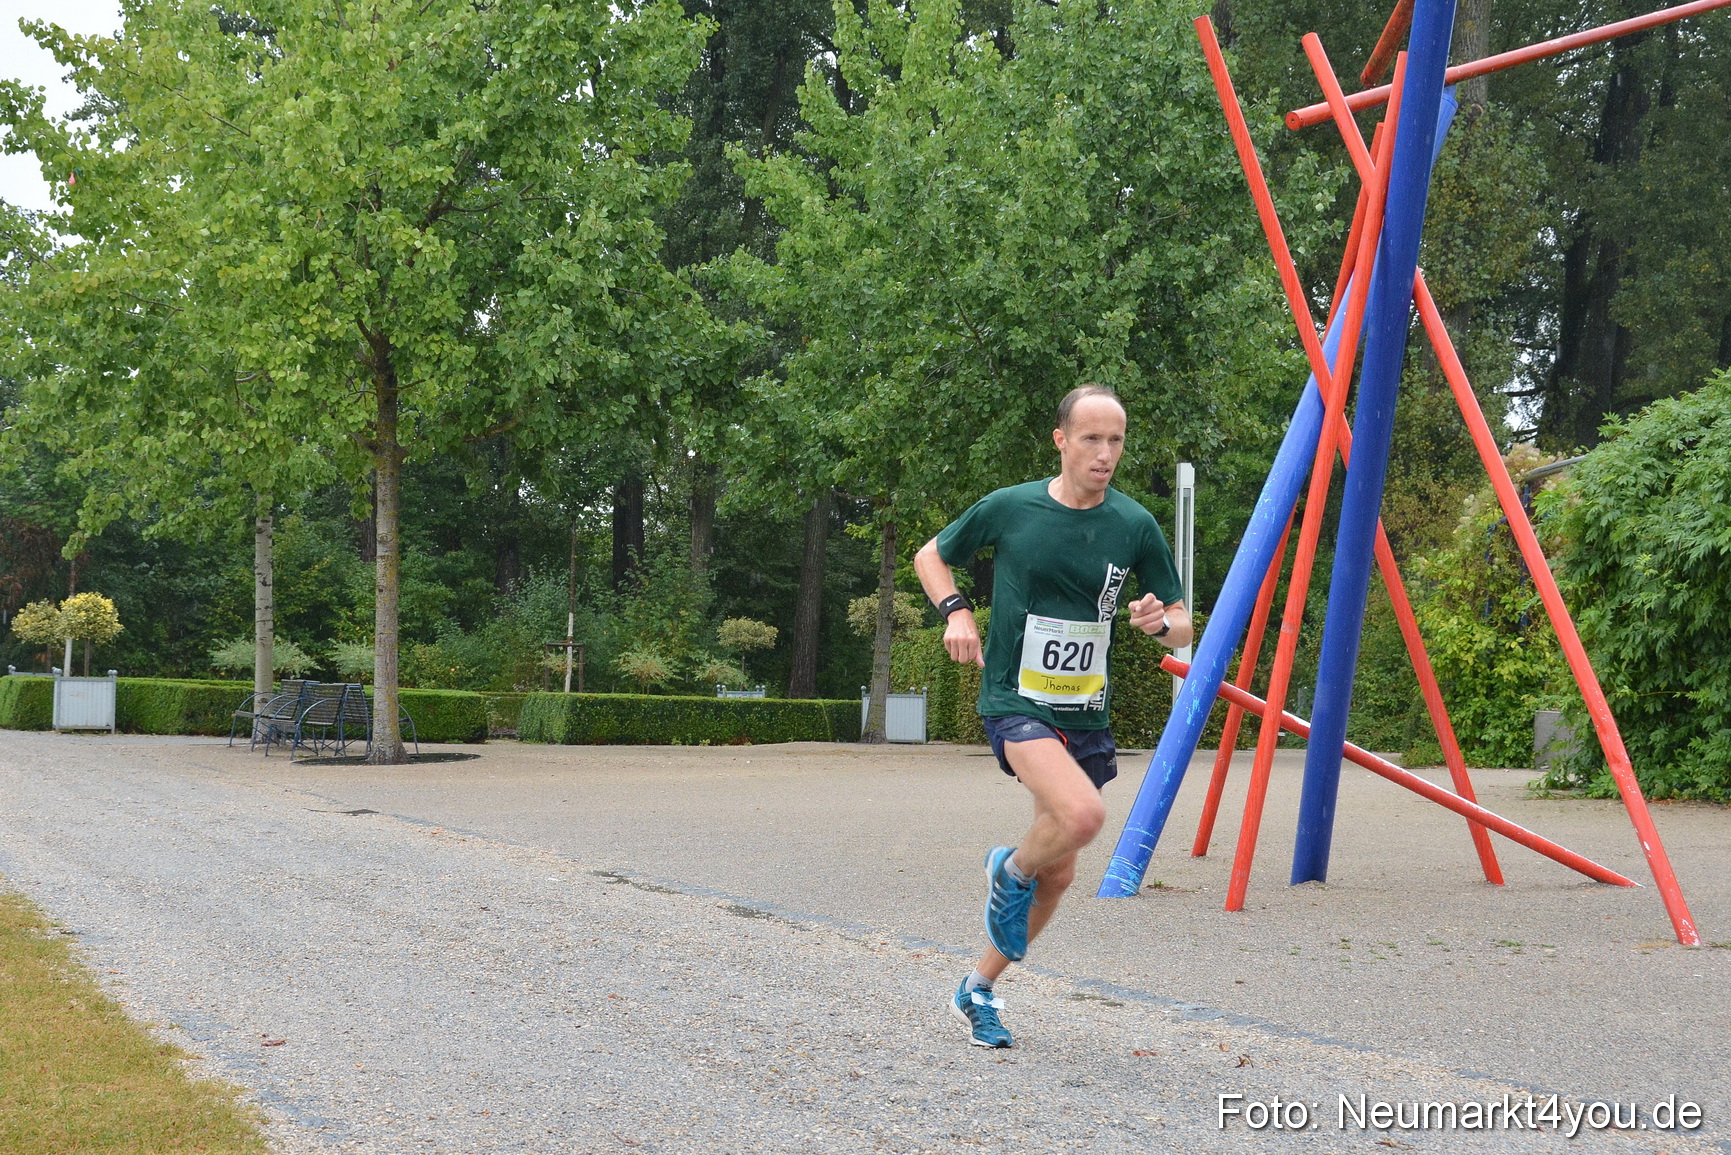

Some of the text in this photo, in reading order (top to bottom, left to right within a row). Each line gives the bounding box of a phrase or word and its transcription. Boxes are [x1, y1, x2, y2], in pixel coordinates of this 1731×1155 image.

[1111, 566, 1126, 583] 21.
[1069, 624, 1106, 634] BOCK
[1042, 640, 1094, 672] 620
[1041, 675, 1081, 692] Thomas
